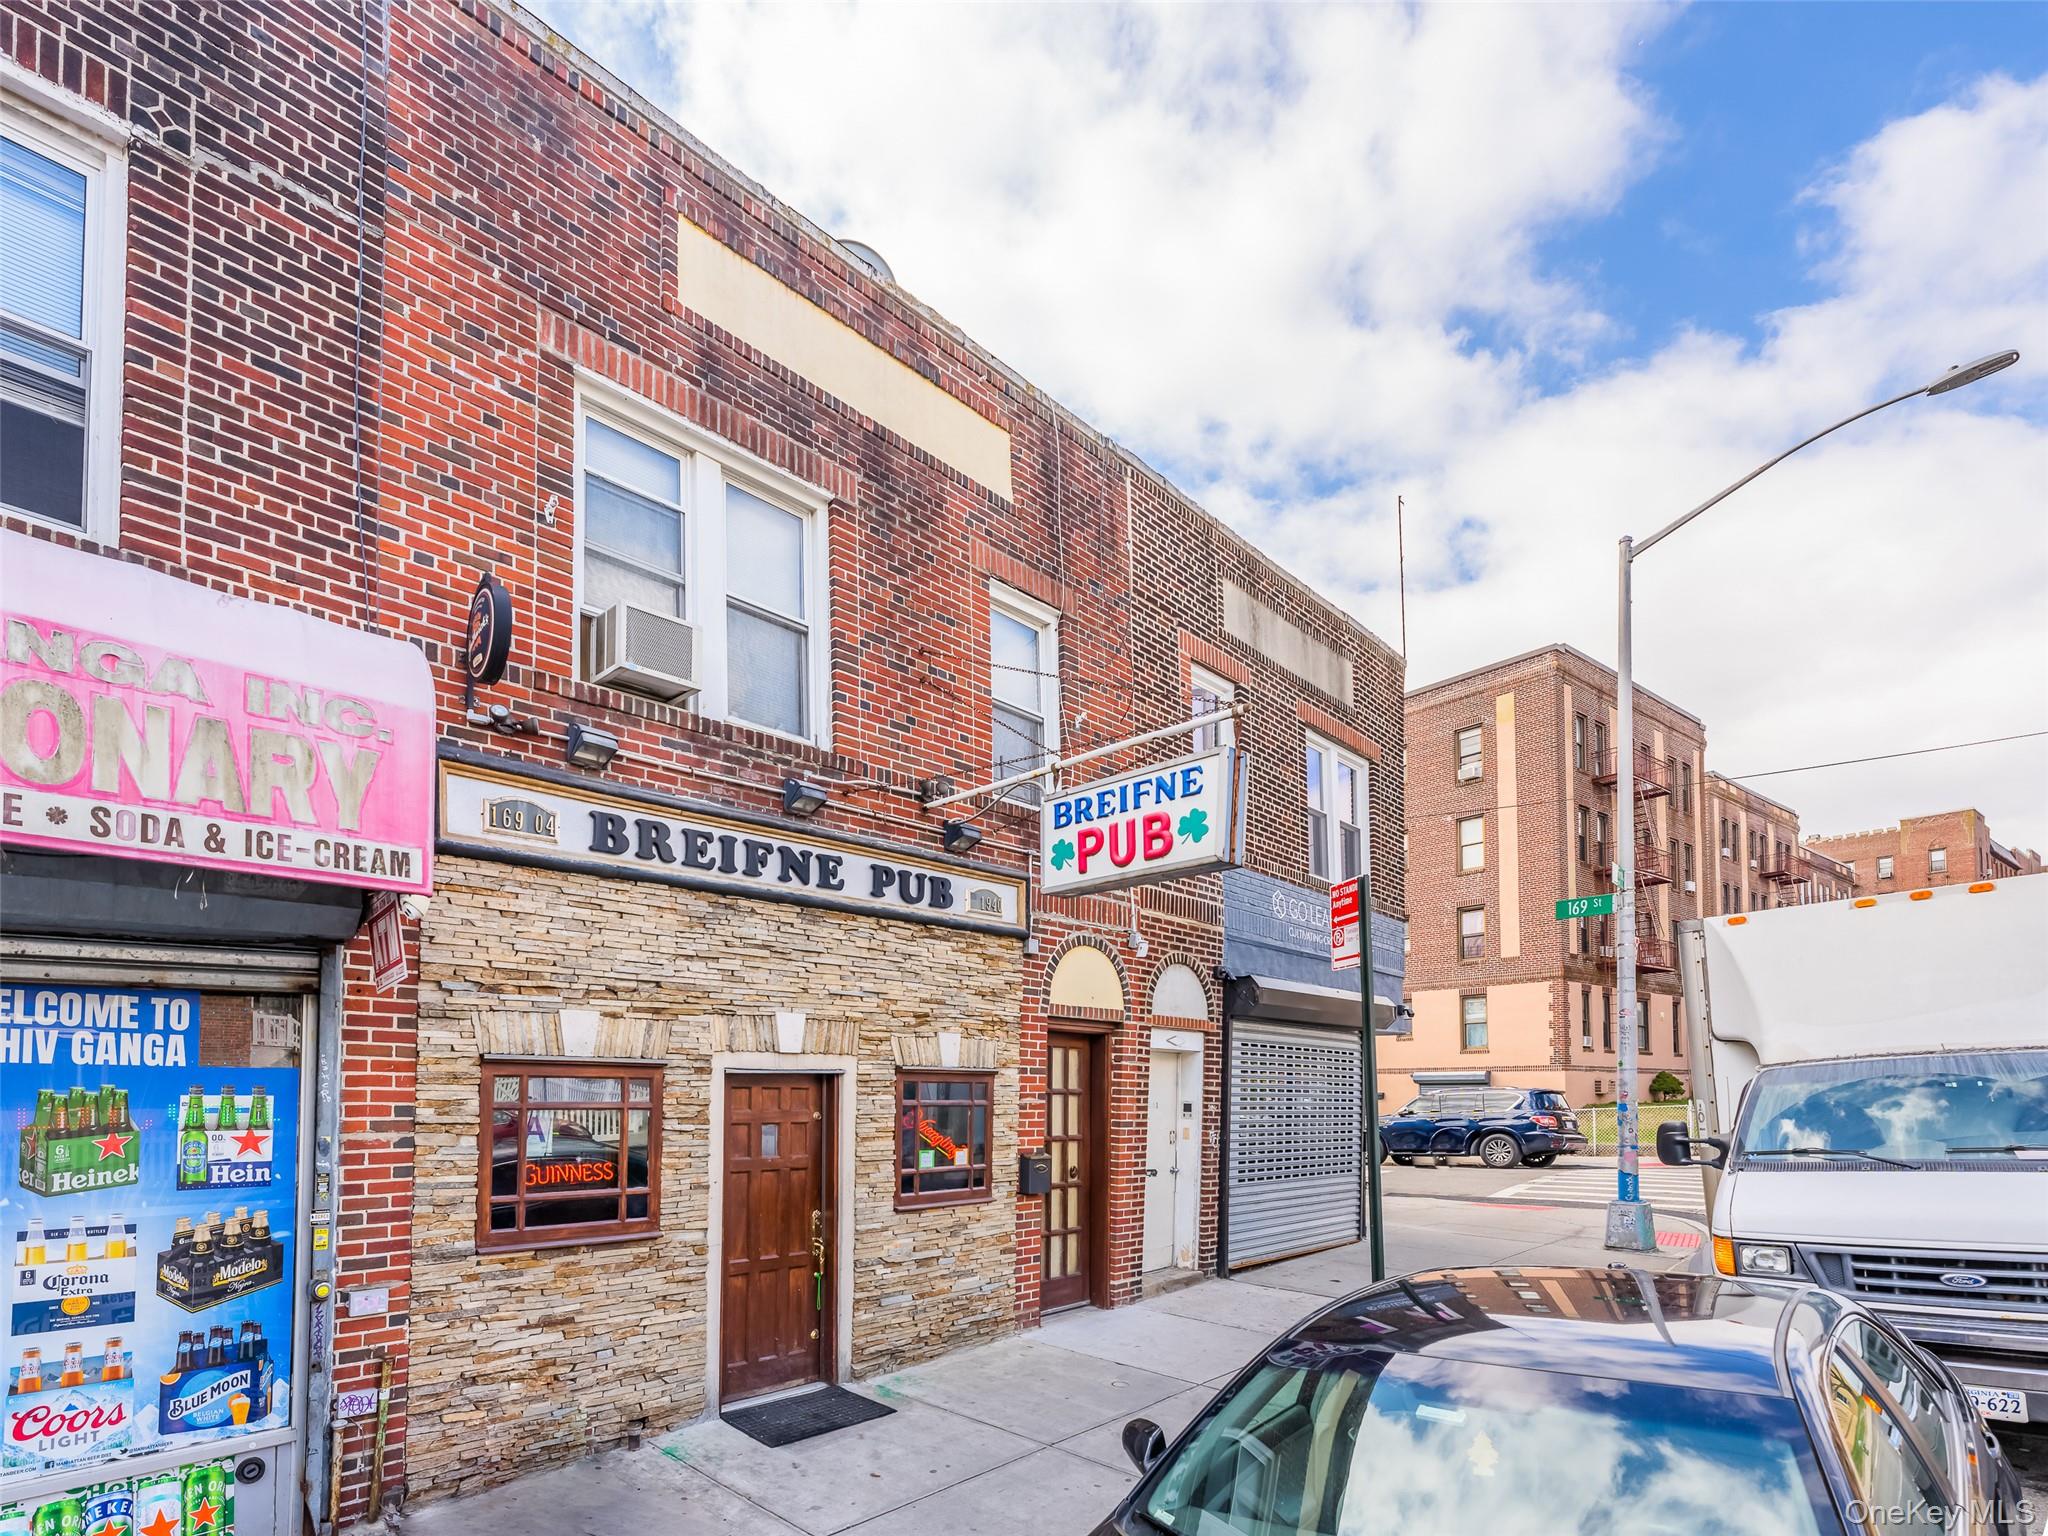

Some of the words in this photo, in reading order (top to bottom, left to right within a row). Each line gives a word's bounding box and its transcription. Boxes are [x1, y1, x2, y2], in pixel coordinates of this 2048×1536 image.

[7, 619, 213, 706] NGA
[245, 673, 393, 744] INC.
[0, 679, 383, 831] ONARY
[1053, 765, 1204, 830] BREIFNE
[490, 805, 524, 831] 169
[535, 814, 556, 837] 04
[89, 806, 185, 849] SODA
[204, 823, 226, 854] &
[245, 829, 411, 879] ICE-CREAM
[1077, 811, 1174, 875] PUB
[589, 810, 845, 891] BREIFNE
[870, 863, 954, 909] PUB
[1290, 899, 1307, 921] GO
[1567, 900, 1588, 916] 169
[1593, 898, 1602, 908] St
[151, 997, 190, 1031] TO
[71, 1031, 186, 1067] GANGA
[527, 1115, 546, 1143] A
[55, 1145, 64, 1155] 6
[210, 1164, 271, 1184] Hein
[525, 1162, 614, 1186] GUINNESS
[43, 1273, 109, 1291] Corona
[162, 1264, 187, 1285] Modelo
[219, 1258, 262, 1281] Modelo
[1952, 1276, 1975, 1285] Ford
[60, 1287, 93, 1296] Extra
[168, 1391, 208, 1418] BLUE
[210, 1372, 249, 1399] MOON
[11, 1402, 127, 1441] Coors
[193, 1408, 224, 1418] BELGIAN
[38, 1430, 100, 1452] LIGHT
